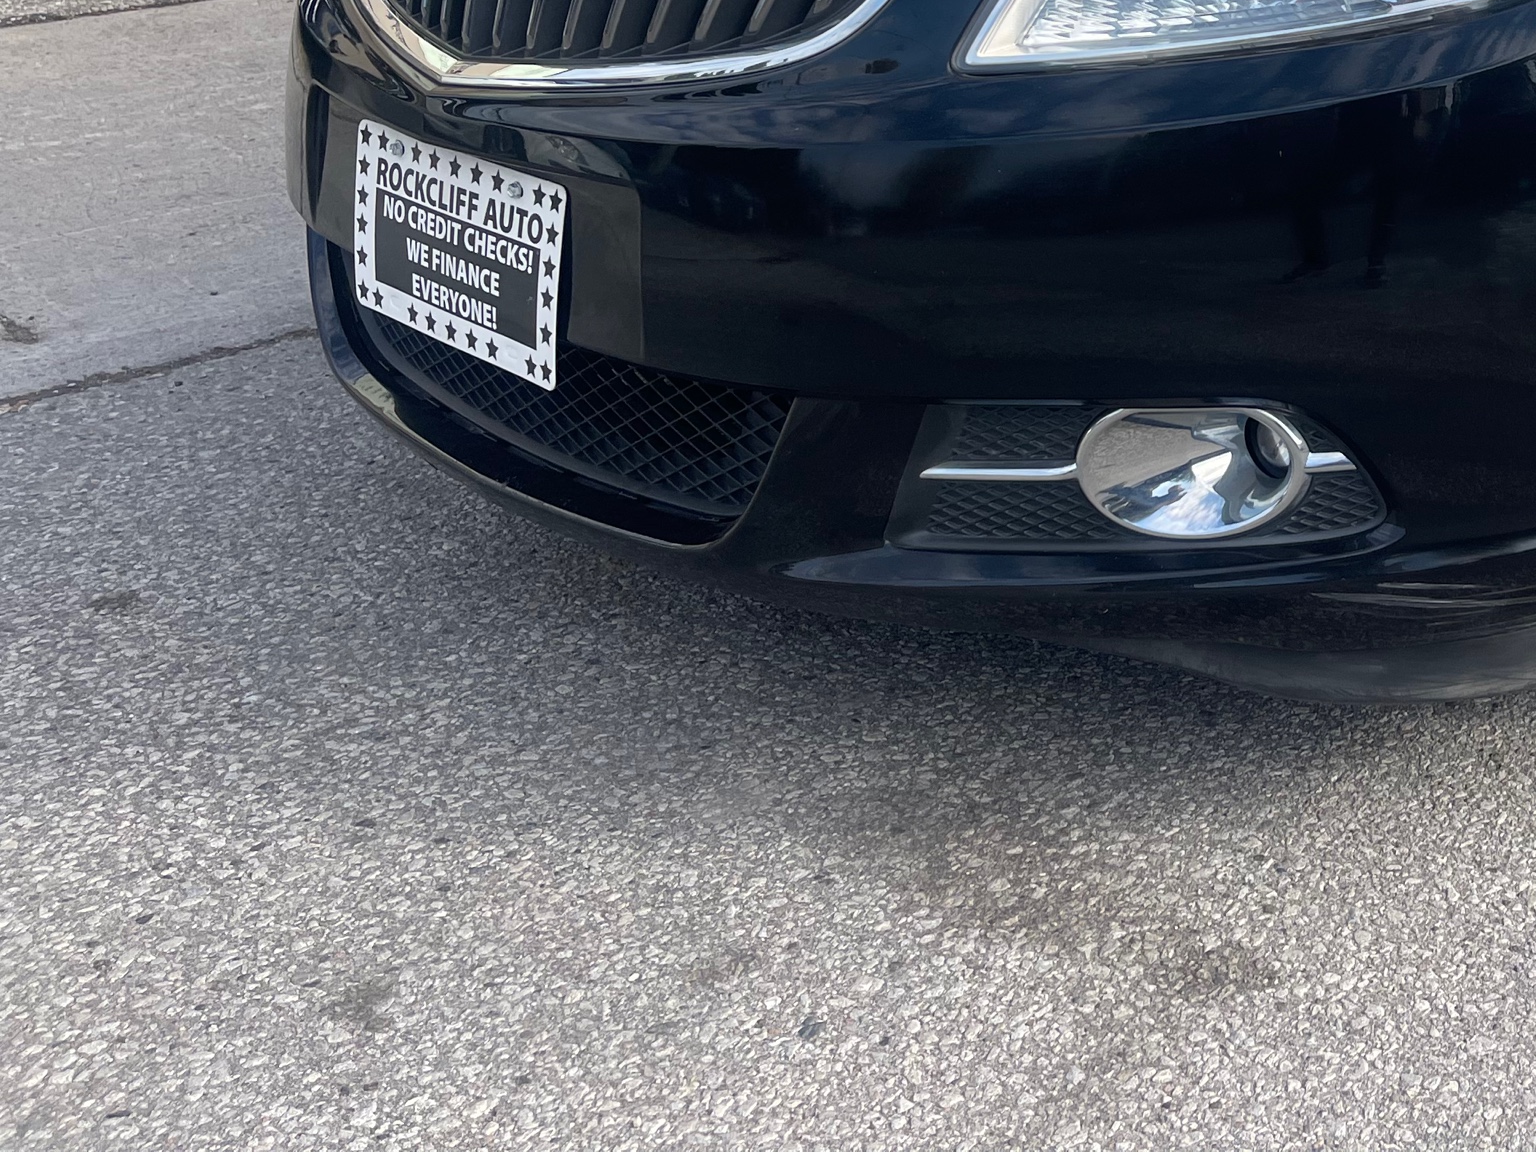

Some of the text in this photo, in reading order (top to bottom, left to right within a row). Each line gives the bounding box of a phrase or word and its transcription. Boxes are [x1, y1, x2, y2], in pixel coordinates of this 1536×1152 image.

[376, 157, 544, 245] ROCKCLIFF AUTO
[383, 194, 533, 275] NO CREDIT CHECKS!
[406, 237, 500, 297] WE FINANCE
[411, 272, 498, 330] EVERYONE!
